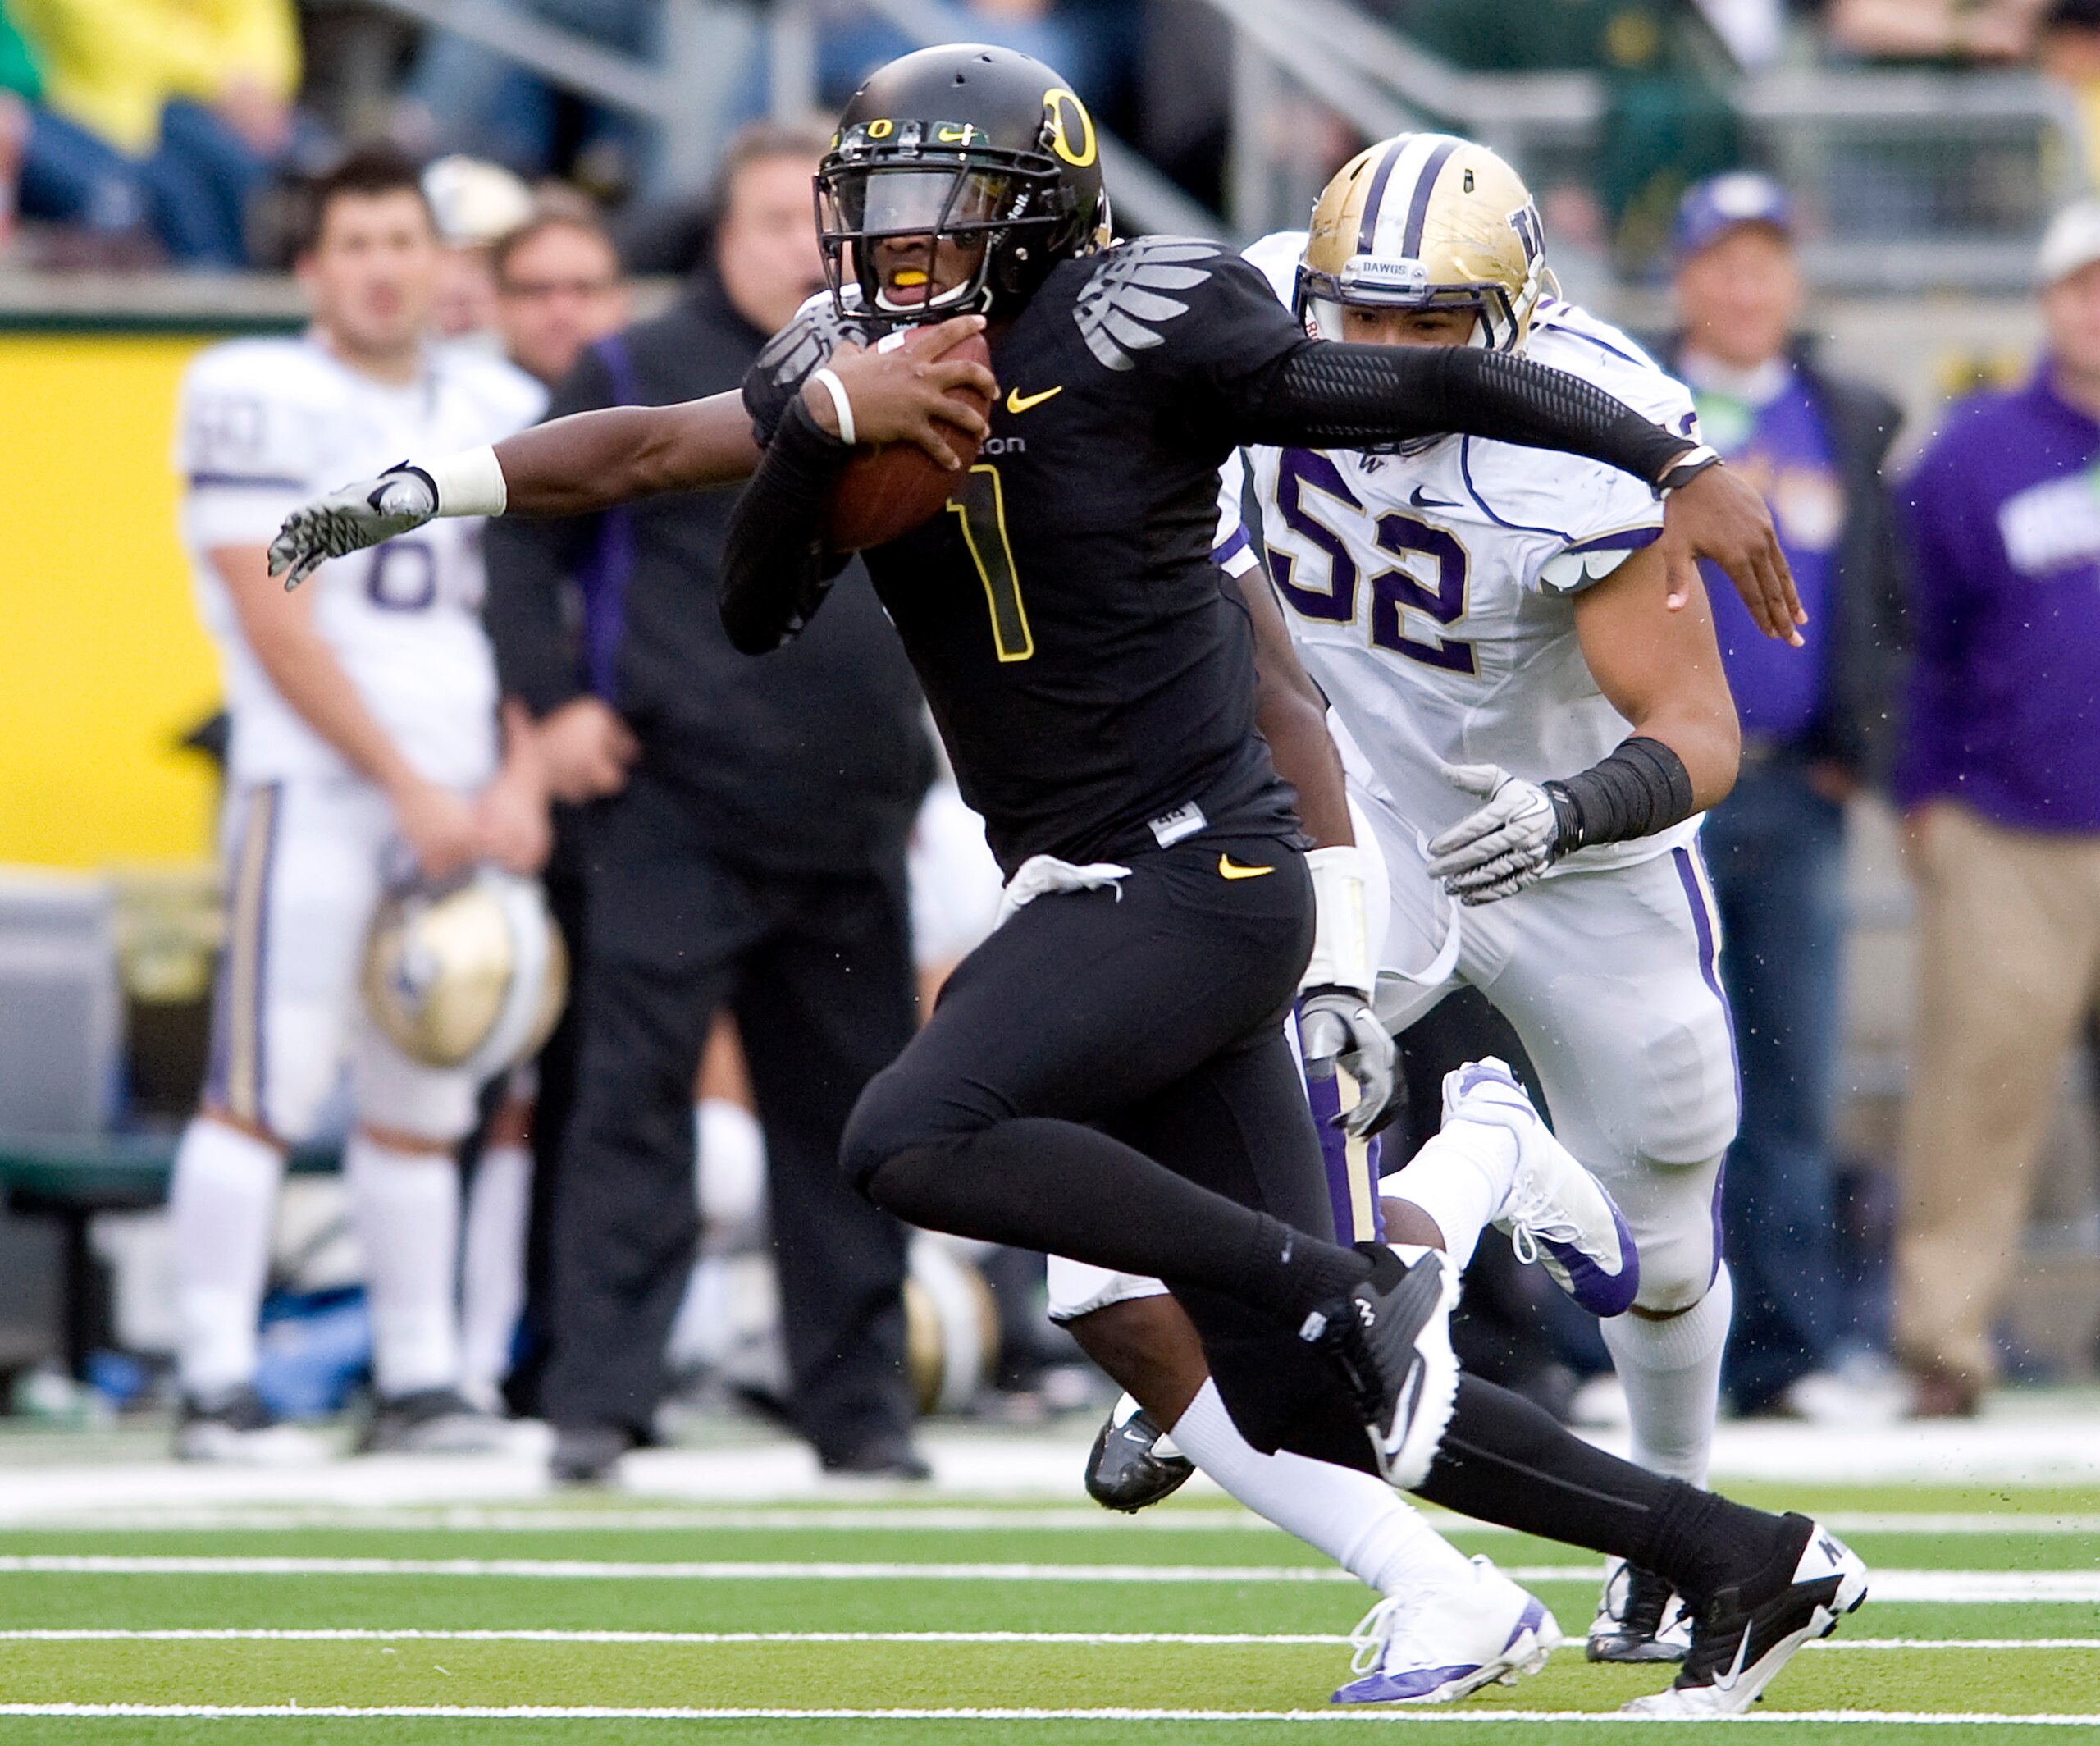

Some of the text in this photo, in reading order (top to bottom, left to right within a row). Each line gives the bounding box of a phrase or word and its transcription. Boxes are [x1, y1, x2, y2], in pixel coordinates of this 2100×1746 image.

[868, 119, 893, 138] O
[1363, 261, 1406, 275] DAWGS
[946, 464, 1034, 662] 1
[1264, 448, 1481, 679] 52
